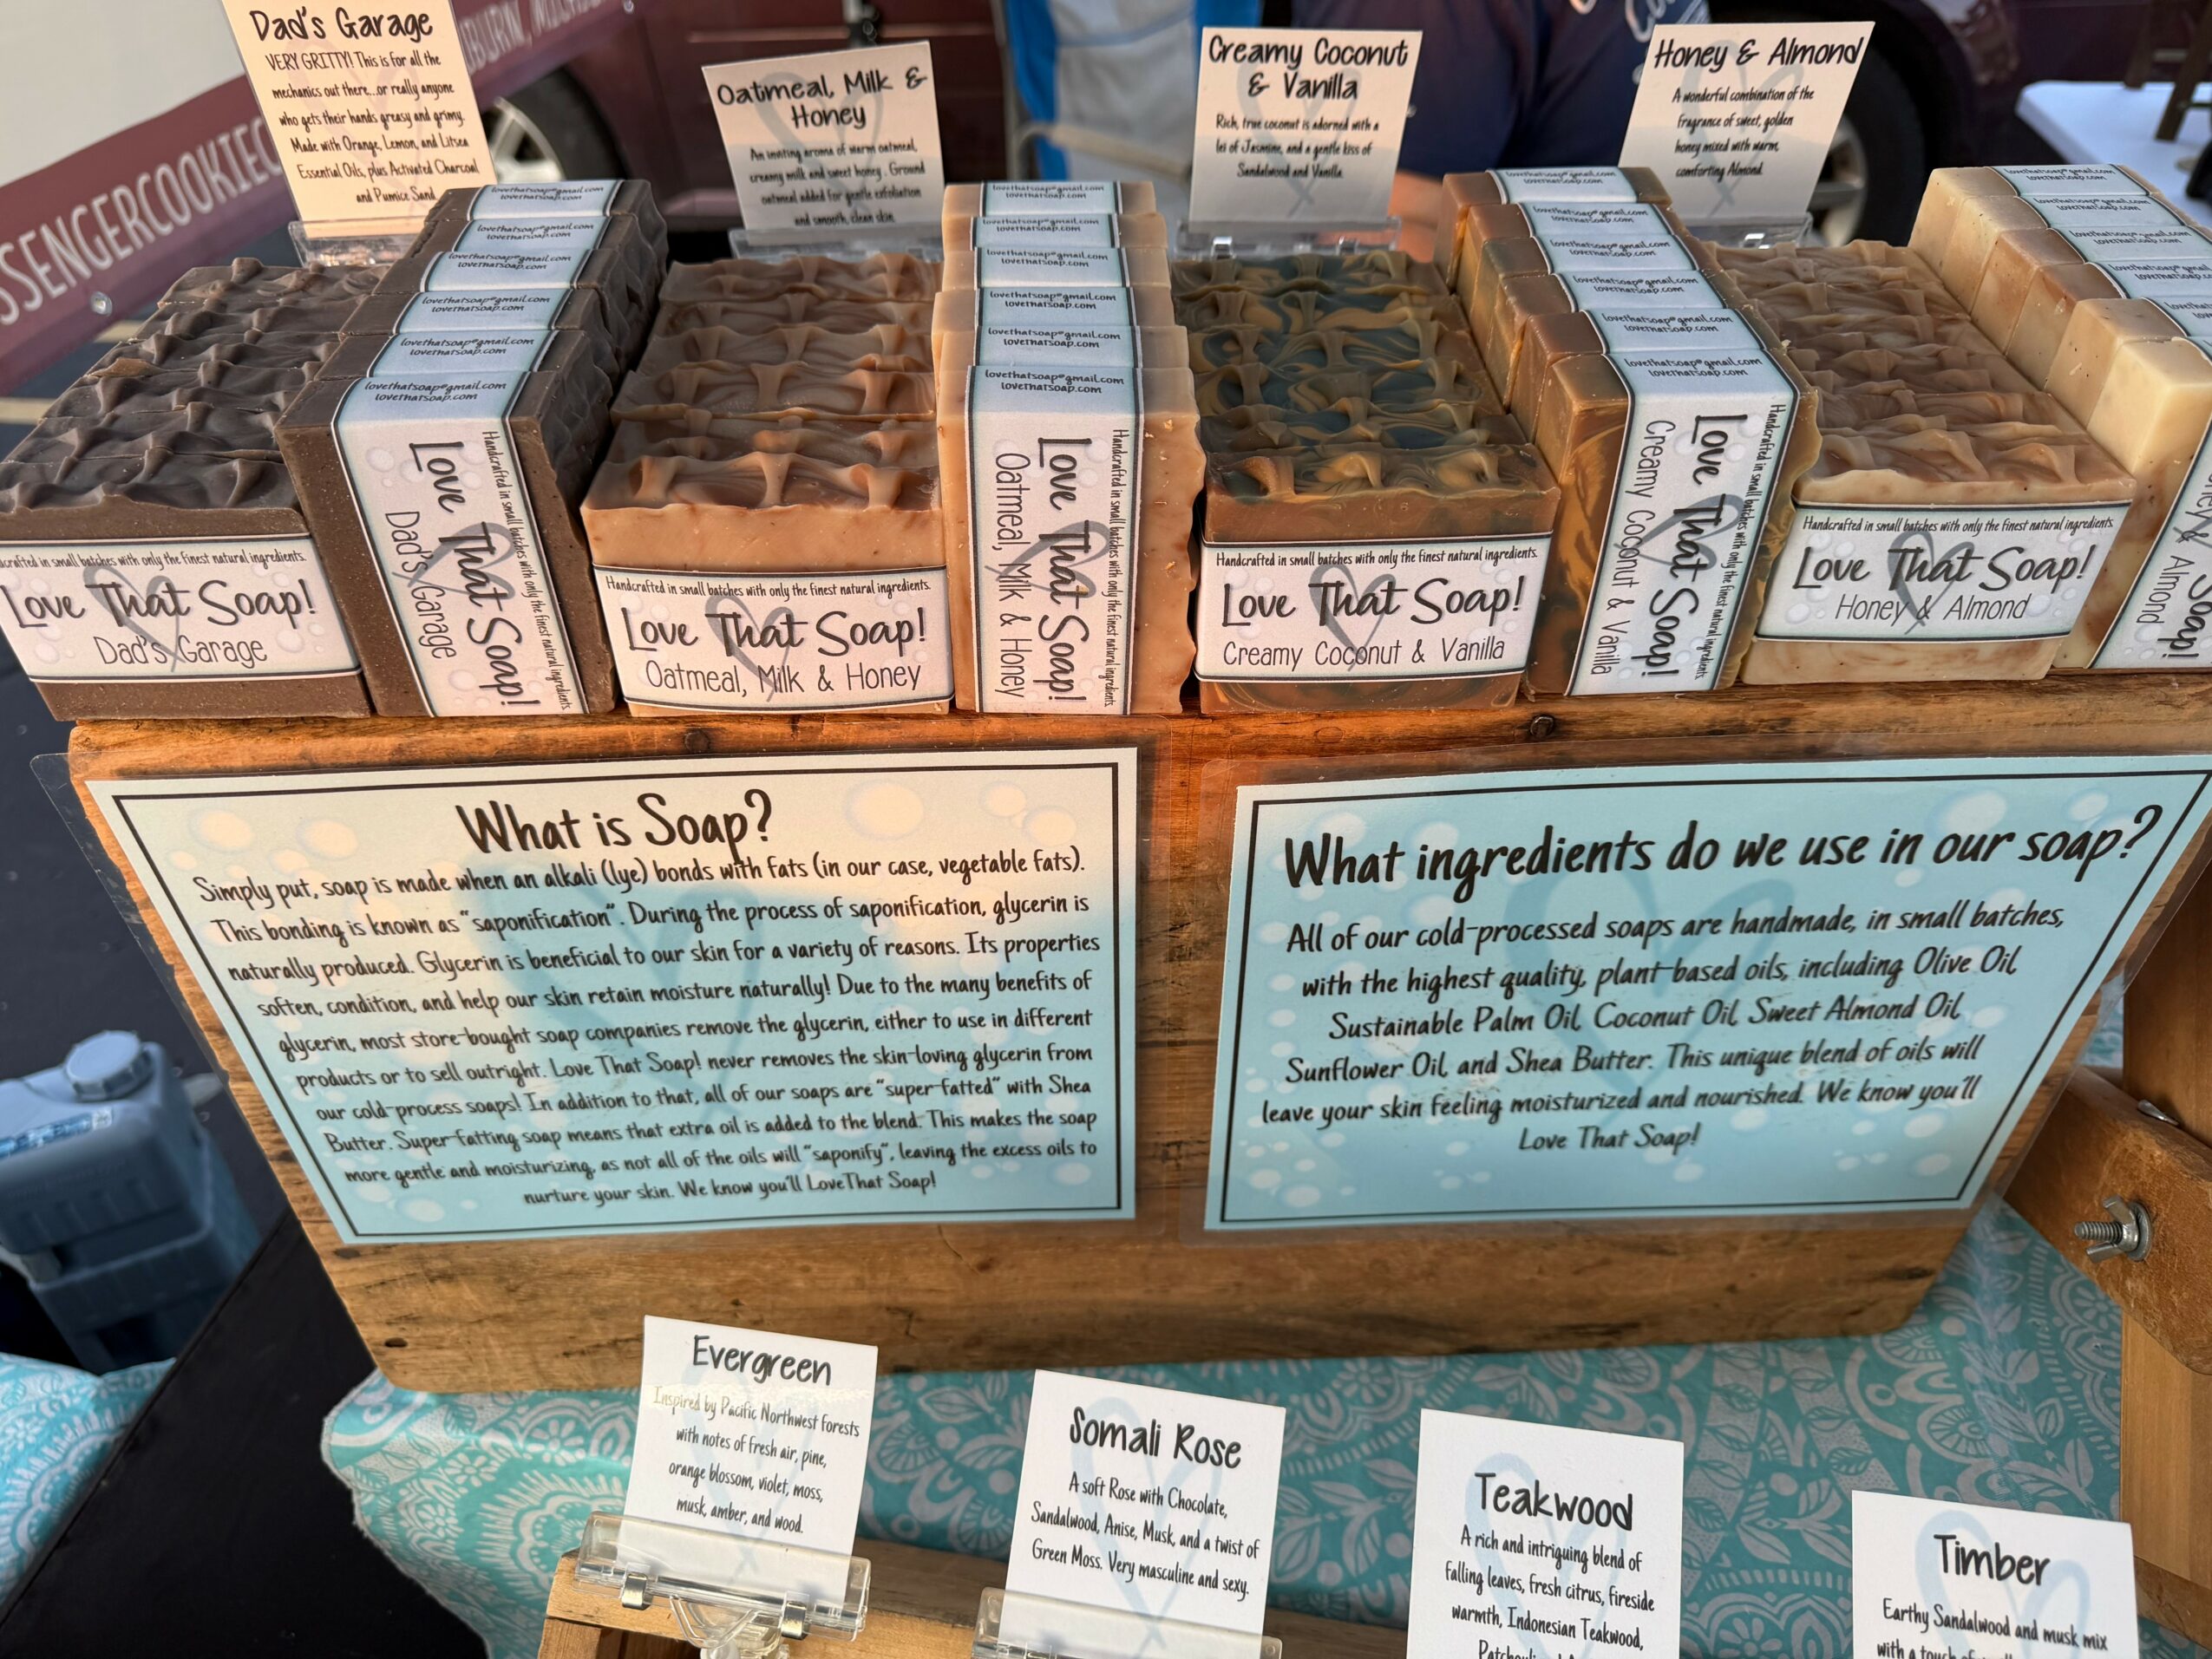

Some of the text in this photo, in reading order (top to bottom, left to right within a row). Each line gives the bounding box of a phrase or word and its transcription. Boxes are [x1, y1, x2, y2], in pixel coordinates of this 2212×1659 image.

[249, 6, 326, 41] Dad's
[336, 7, 433, 42] Garage
[265, 49, 442, 71] VERY GRITTY! This is for all the
[1208, 35, 1409, 70] Creamy Coconut
[1654, 36, 1864, 73] Honey & Almond
[272, 83, 322, 99] mechanics
[324, 84, 340, 97] out
[390, 79, 419, 101] really
[422, 82, 455, 100] anyone
[717, 67, 928, 105] Oatmeal, Milk &
[1247, 72, 1358, 100] & Vanilla
[1672, 85, 1815, 102] A wonderful combination of the
[791, 104, 867, 129] Honey
[1216, 114, 1379, 131] Rich, true coconut is adorned with a
[364, 380, 507, 396] lovethatsoap@gmail.com
[375, 392, 478, 402] lovethatsoap.com
[985, 369, 1124, 385] lovethatsoap@gmail.com
[1001, 382, 1102, 394] lovethatsoap.com
[1591, 420, 1676, 675] Creamy Coconut & Vanilla
[1631, 414, 1748, 677] Love That Soap!
[384, 511, 457, 659] Dad's Garage
[409, 441, 541, 707] Love That Soap!
[605, 574, 932, 602] Handcrafted in small batches with only the finest natural ingredients.
[991, 452, 1032, 698] Oatmeal, Milk & Honey
[1032, 437, 1093, 701] Love That Soap!
[1792, 544, 2096, 594] Love That Soap!
[2136, 555, 2195, 624] Almond
[0, 578, 317, 630] Love That Soap!
[1221, 576, 1525, 628] Love That Soap!
[1835, 593, 2032, 627] Honey & Almond
[93, 634, 268, 669] Dad's Garage
[621, 607, 926, 657] Love That Soap!
[1223, 636, 1505, 672] Creamy Coconut & Vanilla
[645, 659, 921, 698] Oatmeal, Milk & Honey
[455, 787, 774, 867] What is Soap?
[1284, 804, 2164, 904] What ingredients do we use in our soap?
[193, 846, 1086, 910] Simply put, soap is made when an alkali (lye) bonds with fats (in our case, vegetable fats).
[692, 1335, 831, 1386] Evergreen
[676, 1427, 828, 1471] with notes of fresh air, pine,
[1070, 1406, 1242, 1469] Somali Rose
[1069, 1471, 1228, 1519] A soft Rose with Chocolate,
[1475, 1473, 1633, 1531] Teakwood
[1934, 1534, 2051, 1586] Timber
[1882, 1597, 2108, 1650] Earthy Sandalwood and musk mix
